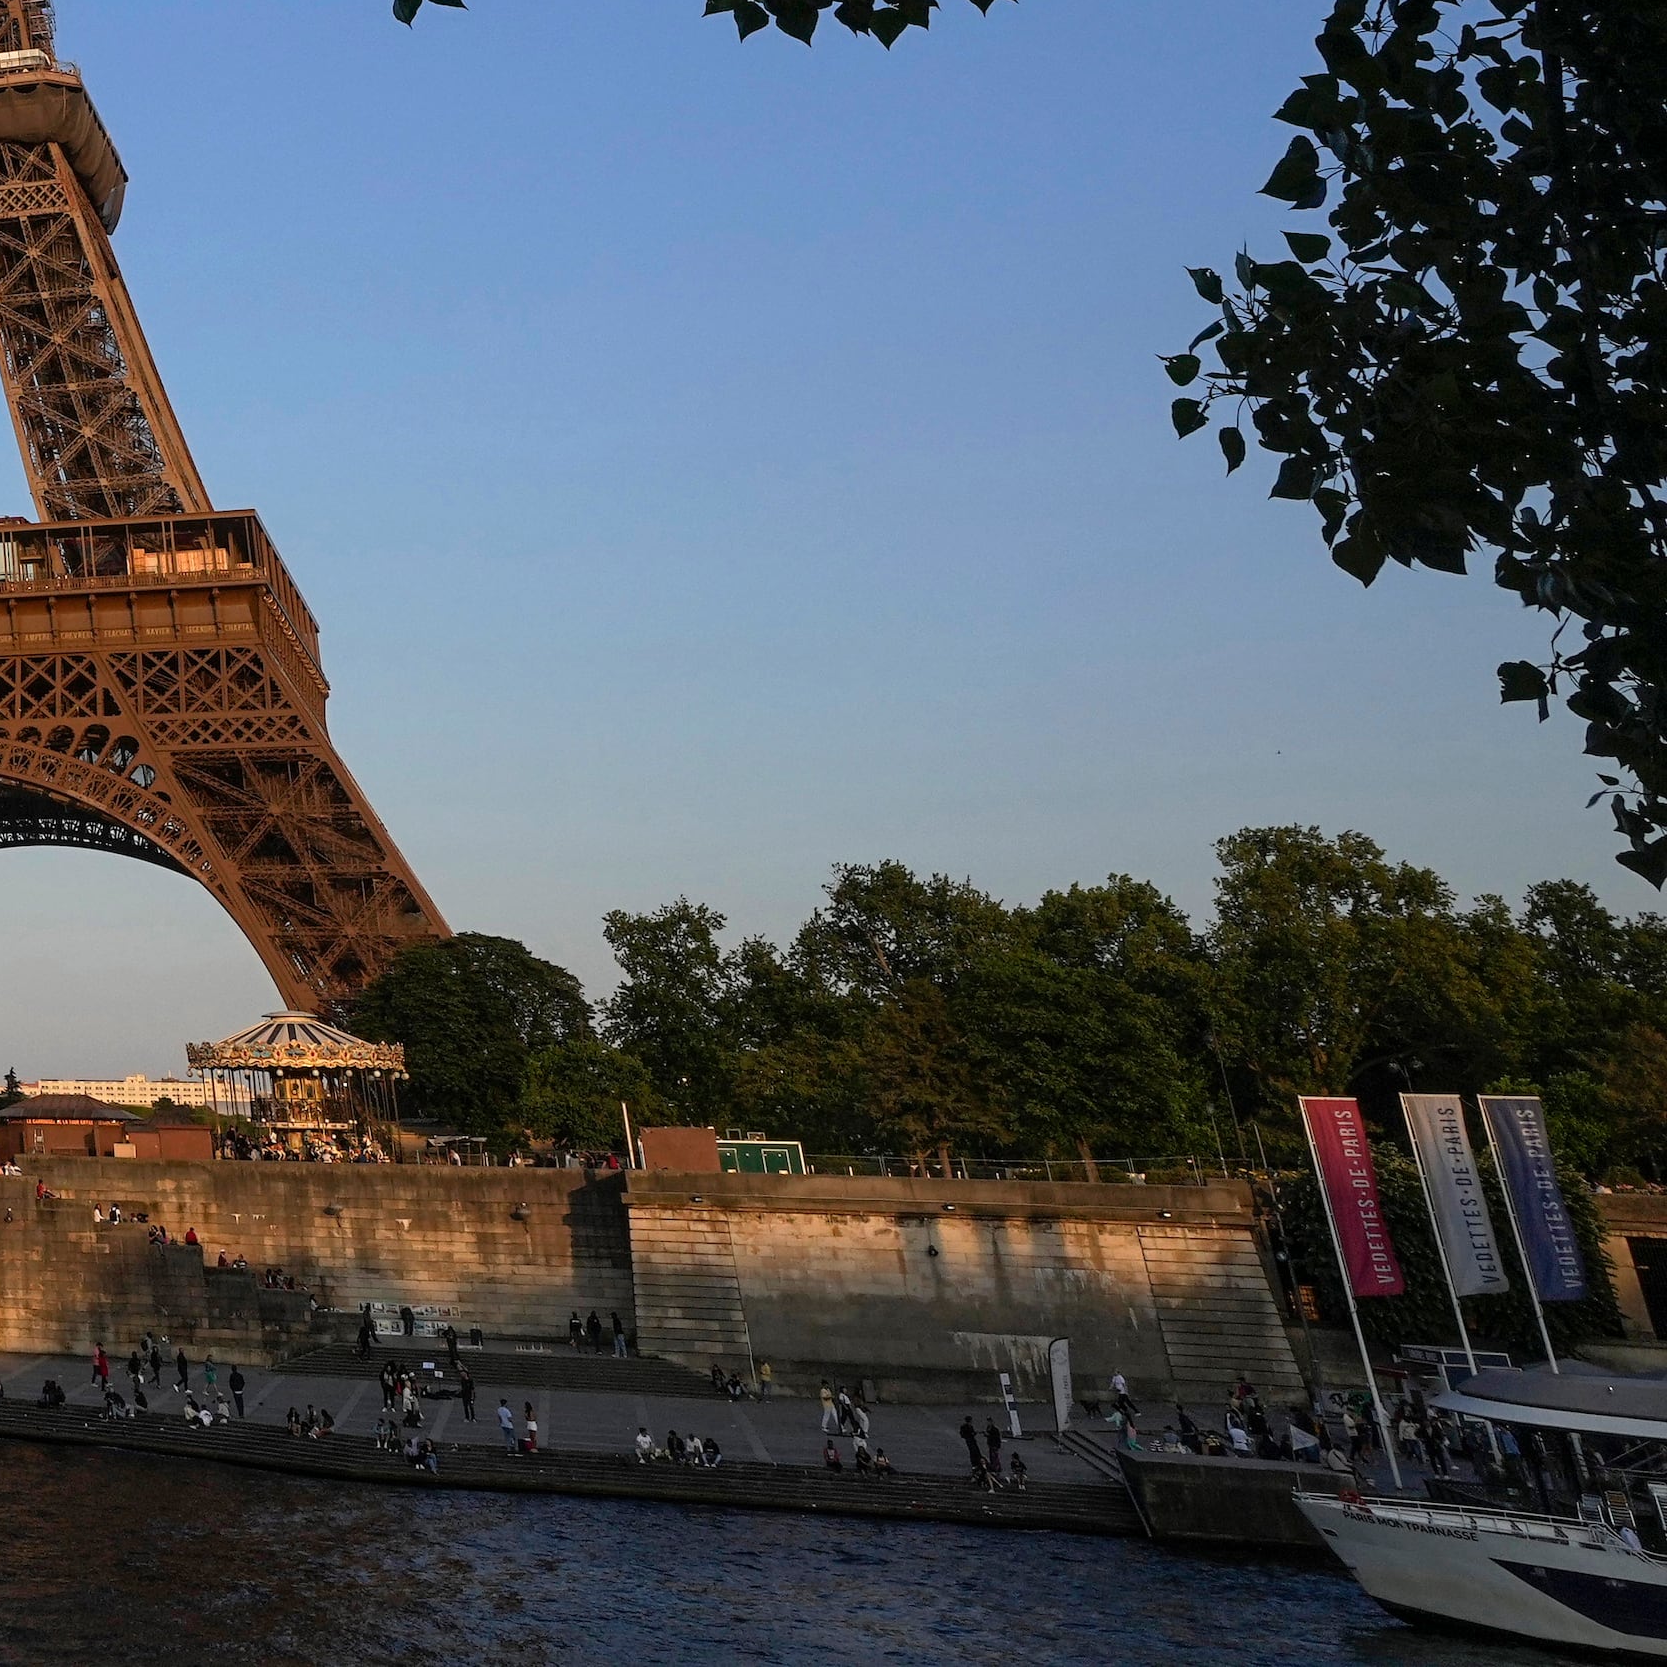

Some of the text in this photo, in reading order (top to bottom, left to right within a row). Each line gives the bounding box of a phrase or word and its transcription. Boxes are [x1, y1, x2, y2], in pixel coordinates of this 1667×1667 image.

[1334, 1109, 1396, 1285] VEDETTES DE PARIS
[1437, 1107, 1501, 1284] VEDETTES DE PARIS
[1516, 1108, 1584, 1289] VEDETTES DE PARIS
[1342, 1510, 1376, 1525] PARIS
